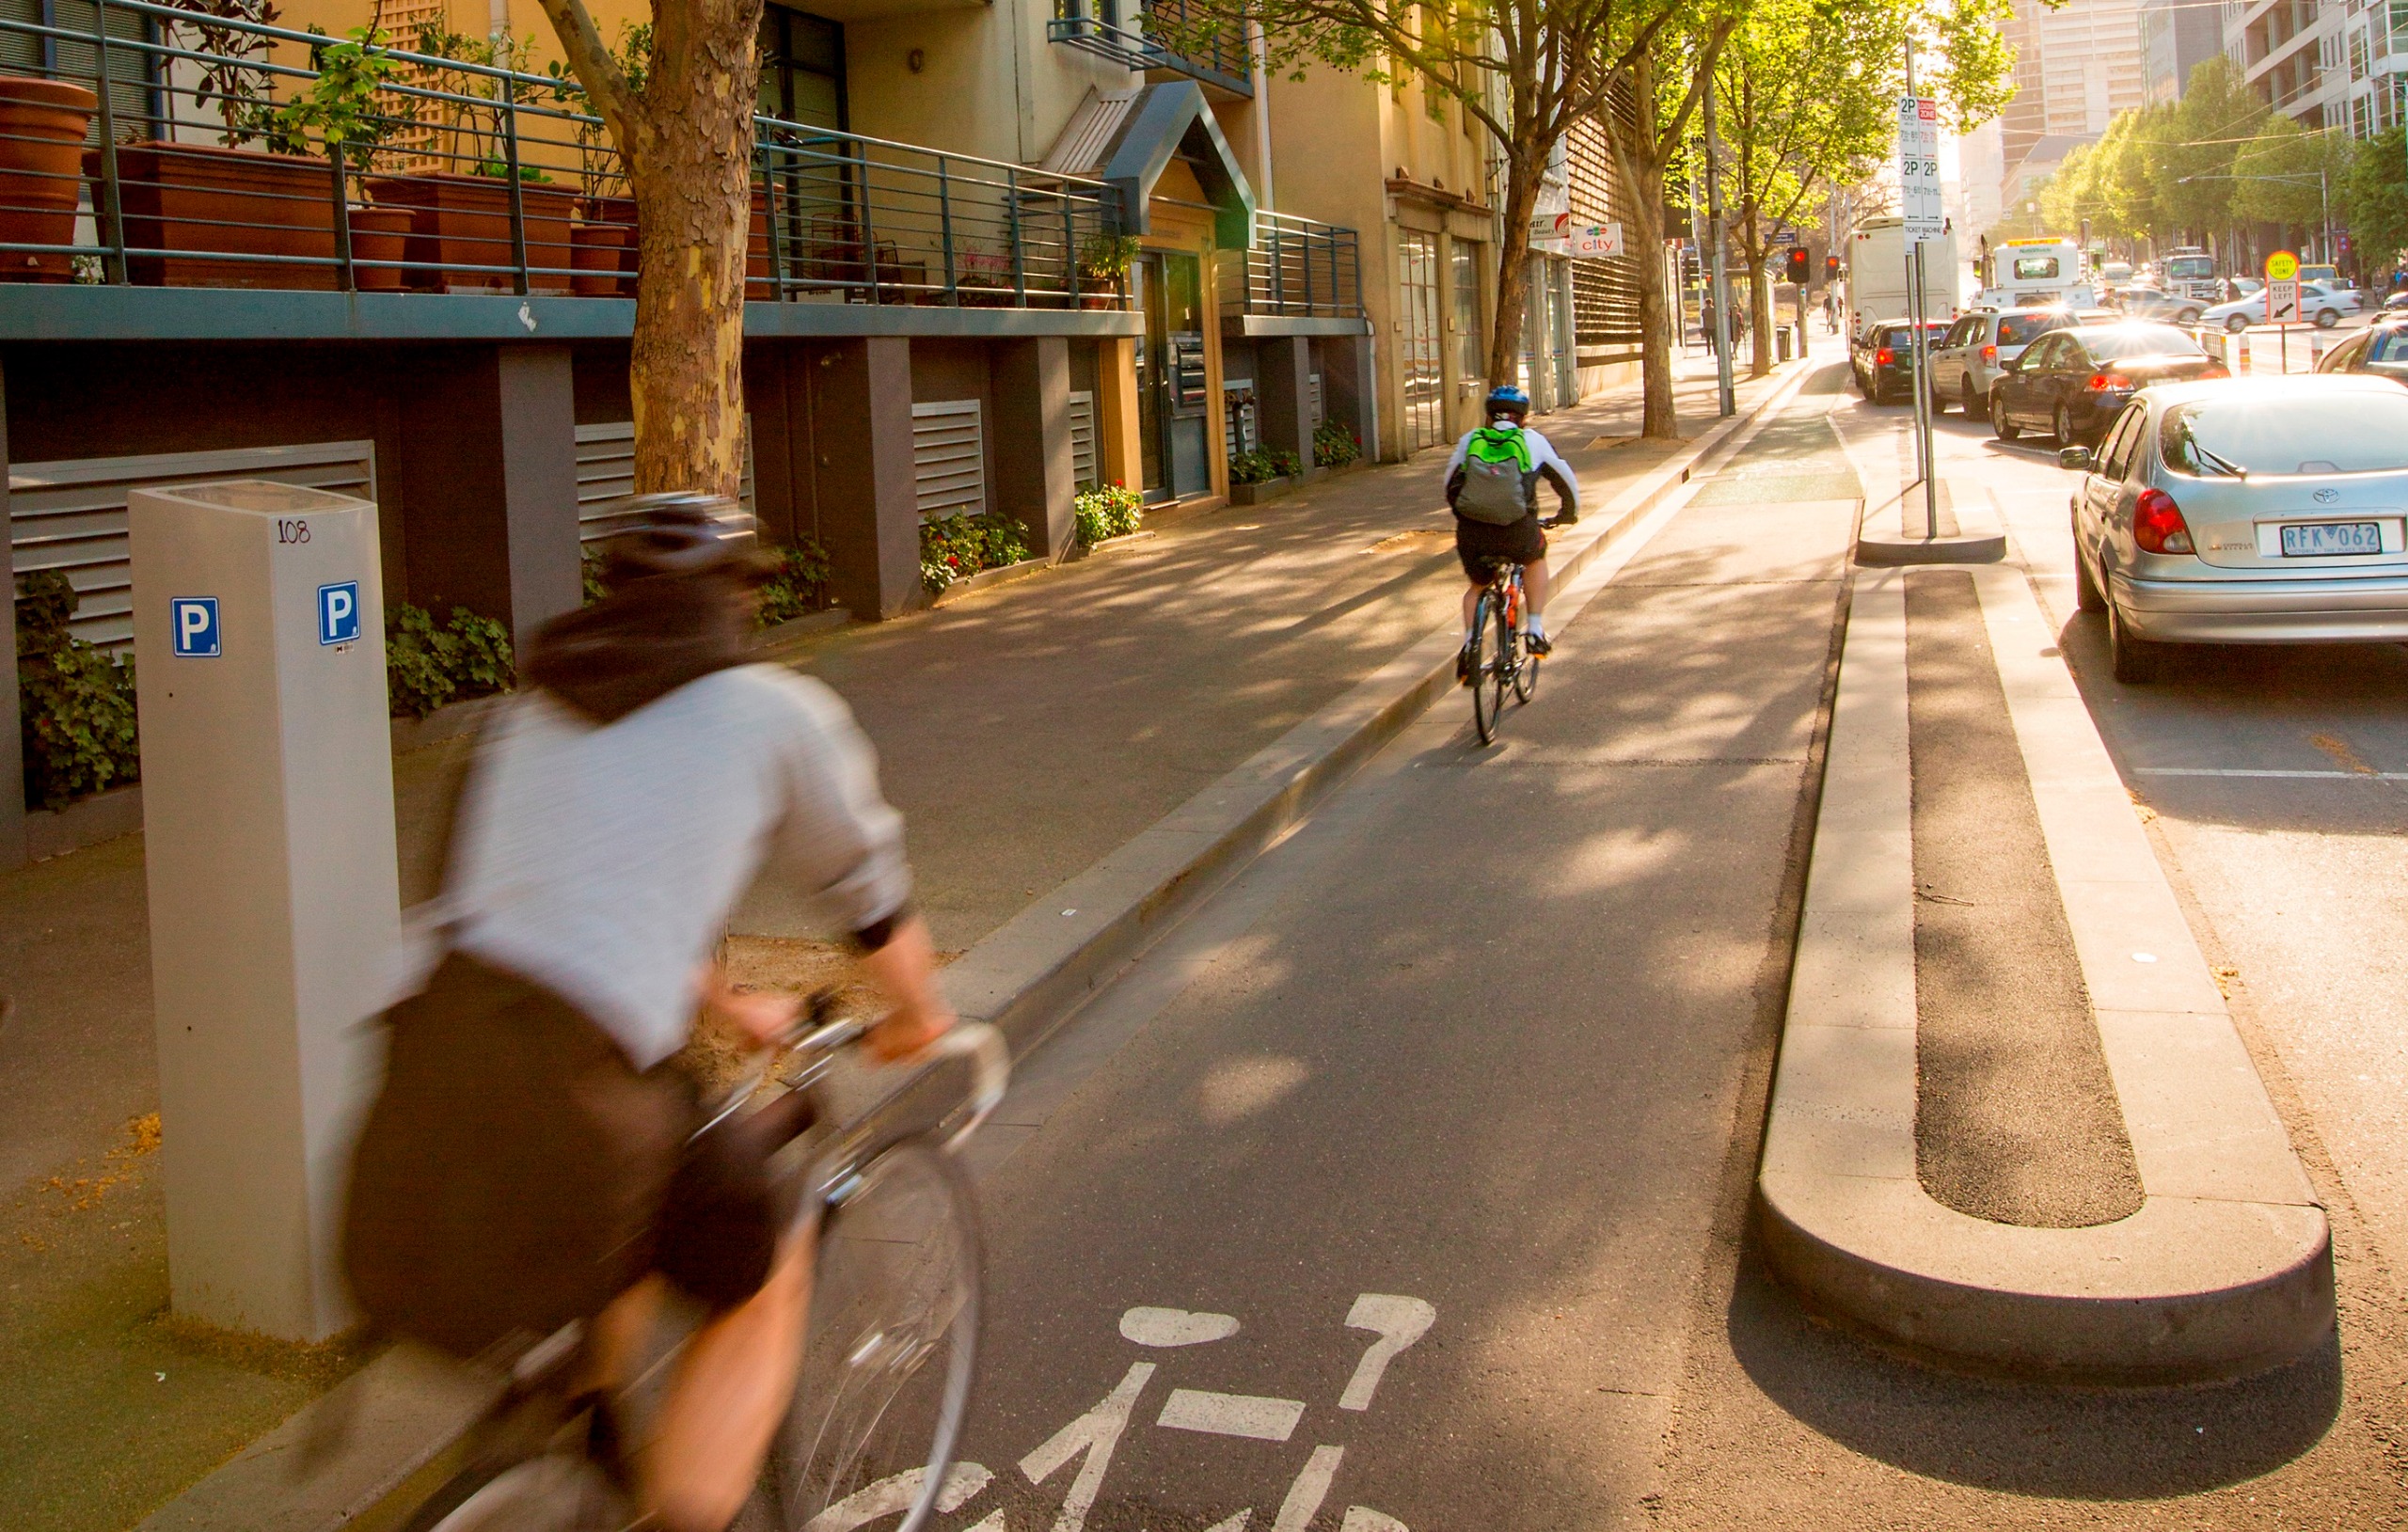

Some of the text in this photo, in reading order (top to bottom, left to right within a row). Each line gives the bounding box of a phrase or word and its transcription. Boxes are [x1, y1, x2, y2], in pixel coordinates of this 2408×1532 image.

[1901, 98, 1916, 113] 2P
[1920, 110, 1935, 118] ZONE
[1903, 161, 1918, 176] 2P
[1924, 162, 1938, 176] 2P
[1582, 239, 1613, 252] city
[278, 520, 310, 544] 108
[2286, 527, 2377, 548] RFK 062
[327, 591, 352, 637] P
[181, 605, 209, 650] P
